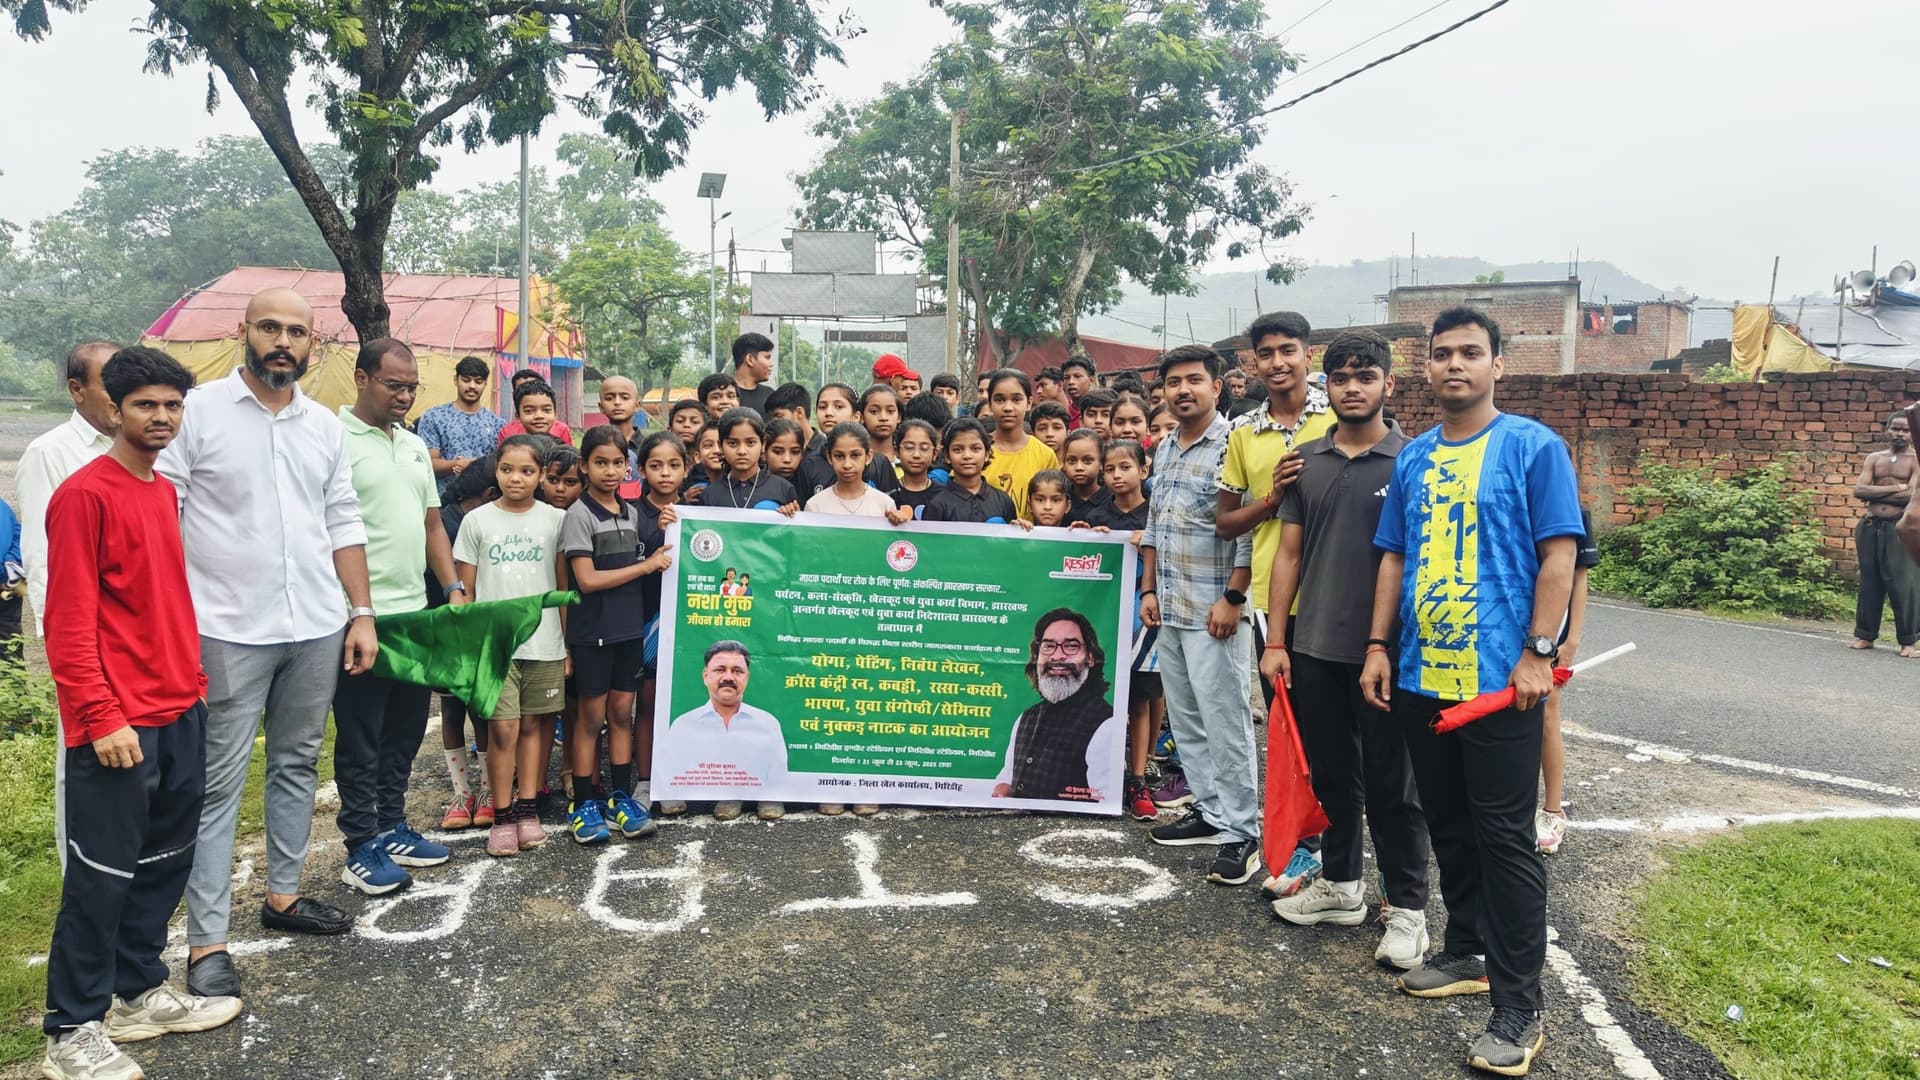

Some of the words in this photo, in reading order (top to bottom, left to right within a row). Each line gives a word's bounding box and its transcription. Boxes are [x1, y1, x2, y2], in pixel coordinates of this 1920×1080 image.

[503, 534, 523, 546] Life
[525, 535, 533, 544] is
[488, 544, 544, 566] Sweet
[799, 574, 819, 583] मादक
[843, 576, 852, 584] पर
[853, 575, 867, 585] रोक
[868, 576, 876, 585] के
[877, 575, 891, 586] लिए
[686, 593, 721, 610] नशा
[723, 595, 754, 616] मुक्त
[775, 589, 805, 600] पर्यटन,
[869, 593, 901, 607] खेलकूद
[903, 595, 915, 605] एवं
[918, 597, 934, 608] युवा
[936, 597, 956, 608] कार्य
[958, 598, 989, 610] विभाग,
[686, 612, 712, 626] जीवन
[713, 613, 724, 626] हो
[725, 616, 752, 627] हमारा
[828, 606, 860, 619] खेलकूद
[862, 607, 874, 617] एवं
[877, 609, 893, 620] युवा
[895, 610, 914, 620] कार्य
[917, 610, 960, 622] निदेशालय
[999, 614, 1008, 625] के
[812, 653, 850, 670] योगा,
[901, 656, 938, 672] निबंध
[941, 658, 985, 677] लेखन,
[785, 673, 817, 688] क्रॉस
[819, 674, 849, 692] कंट्री
[851, 678, 874, 693] रन,
[929, 682, 1008, 700] रस्सा-कस्सी,
[804, 698, 851, 713] भाषण,
[855, 699, 882, 716] युवा
[800, 717, 820, 732] एवं
[868, 722, 907, 734] नाटक
[909, 724, 928, 736] का
[931, 723, 991, 739] आयोजन
[817, 778, 852, 787] आयोजक
[858, 778, 879, 788] जिला
[880, 779, 896, 788] खेल
